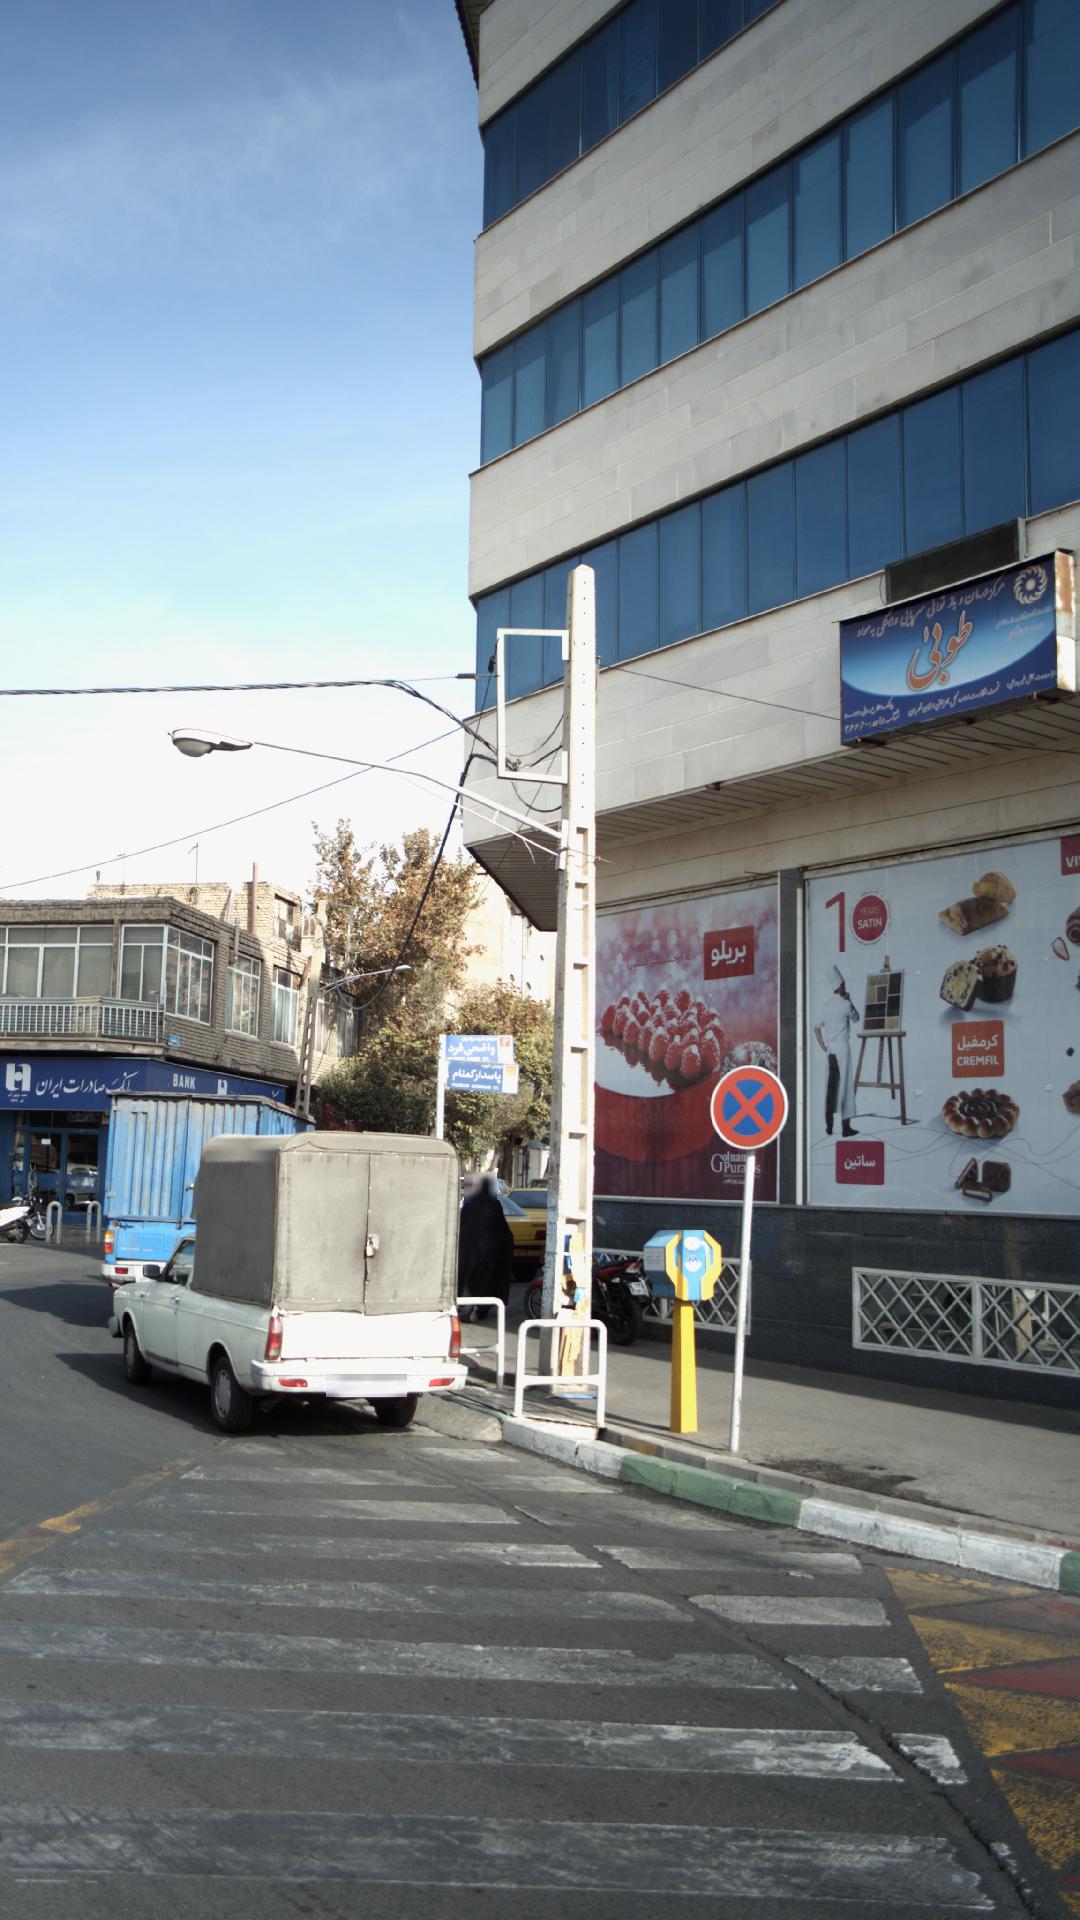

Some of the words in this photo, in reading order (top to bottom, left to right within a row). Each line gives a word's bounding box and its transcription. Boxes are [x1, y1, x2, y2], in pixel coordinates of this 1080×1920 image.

[988, 572, 1005, 600] مرکز
[1065, 855, 1080, 868] VI
[857, 917, 882, 929] SATIN
[710, 940, 747, 967] بریلو
[957, 1033, 999, 1051] کرمفیل
[956, 1055, 999, 1066] CREMFIL
[36, 1077, 63, 1098] ایران
[63, 1079, 106, 1094] صادرات
[105, 1070, 139, 1093] انک
[172, 1072, 196, 1090] BANK
[723, 1161, 761, 1173] Puras
[843, 1153, 876, 1170] ساتین
